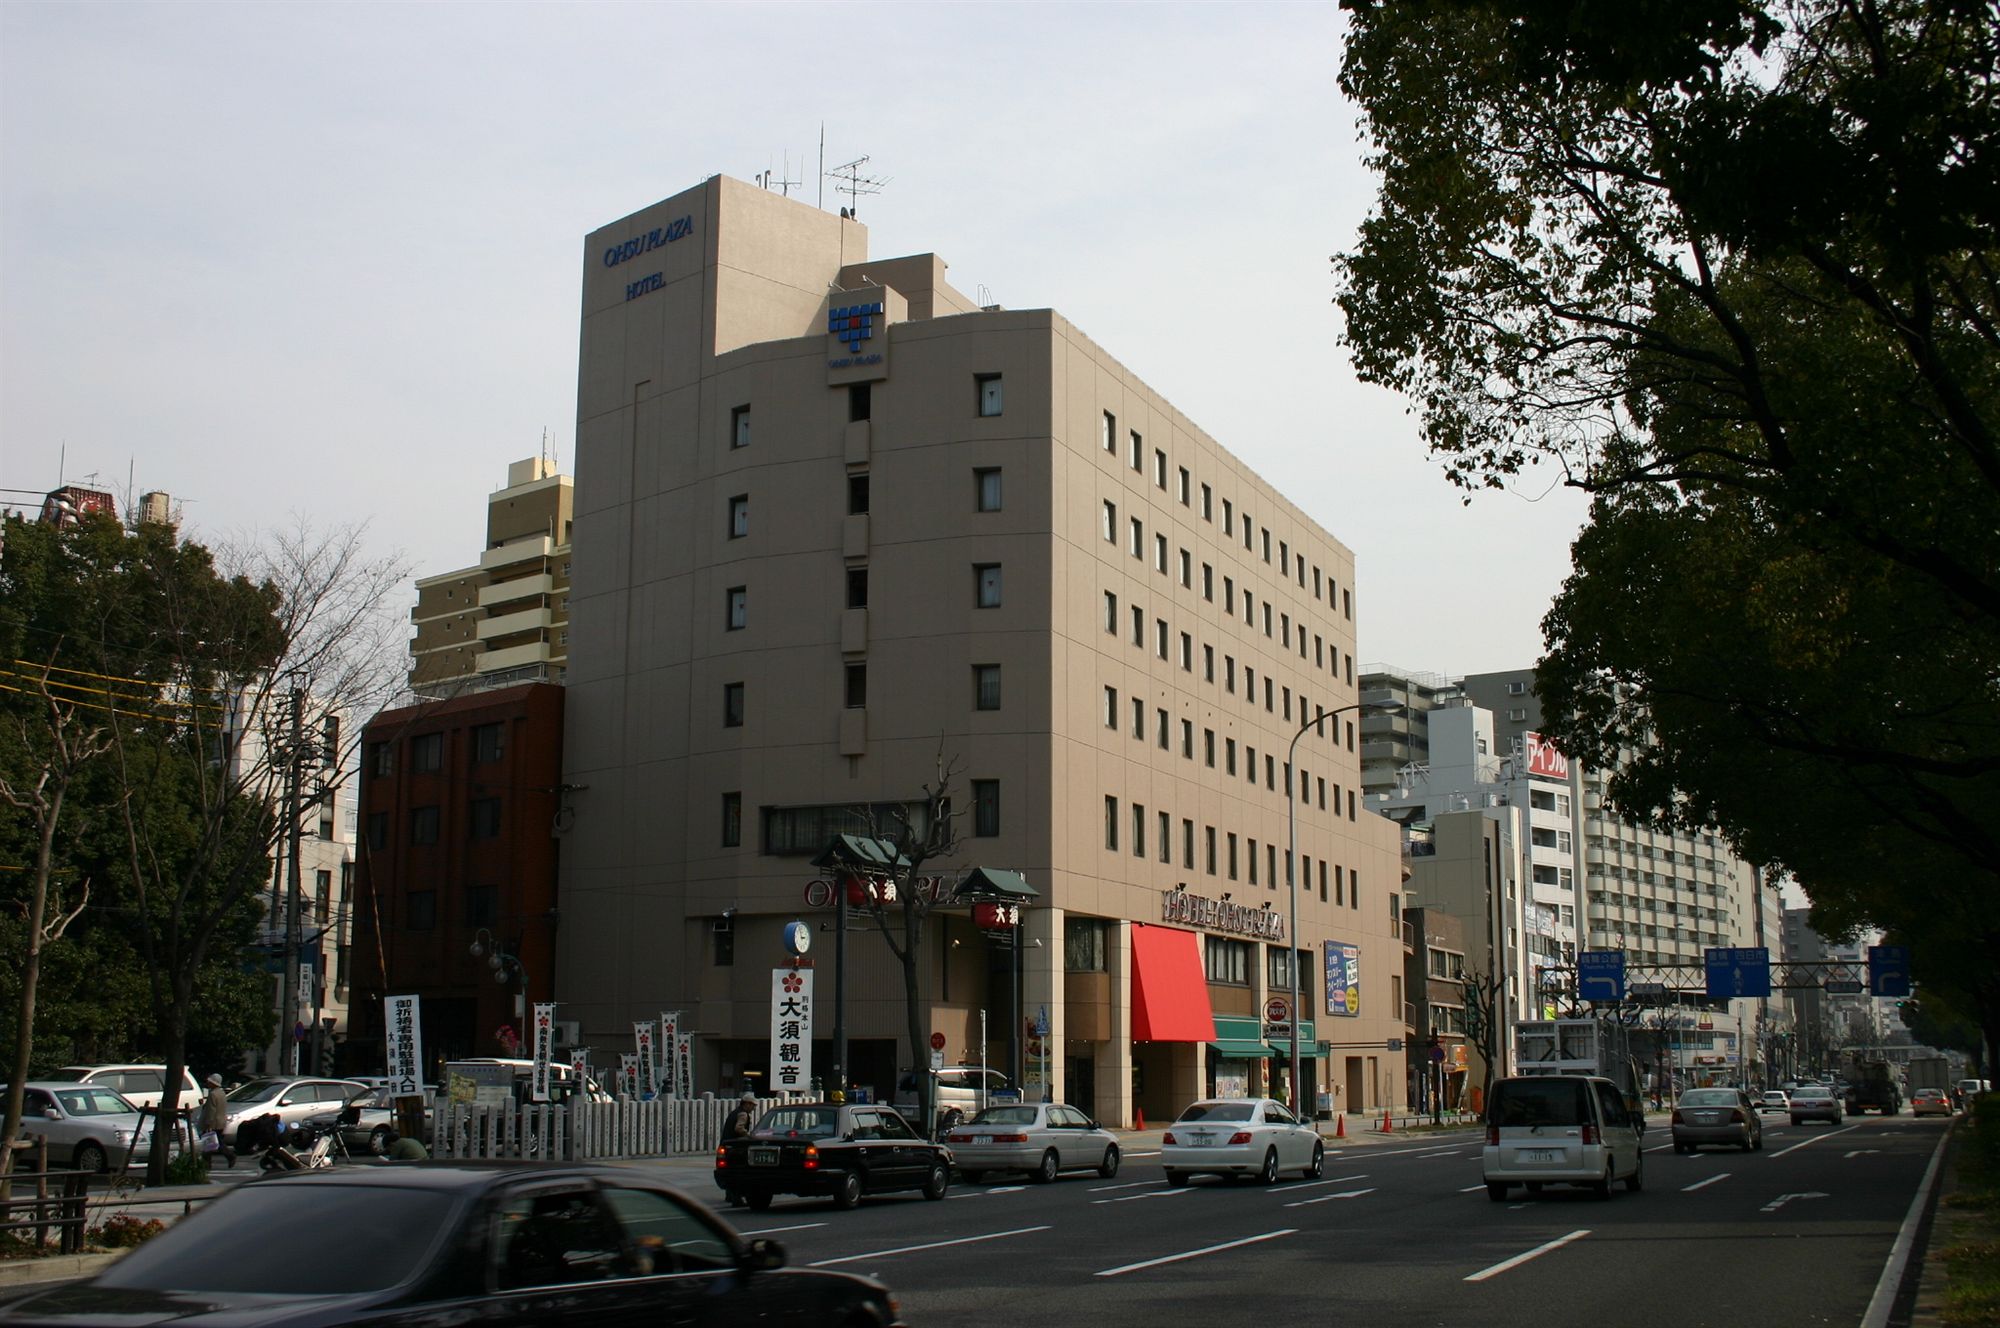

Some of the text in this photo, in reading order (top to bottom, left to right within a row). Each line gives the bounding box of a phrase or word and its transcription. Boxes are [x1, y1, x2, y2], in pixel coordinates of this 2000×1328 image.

[604, 215, 693, 268] OHSU PLAZA
[626, 272, 667, 301] HOTEL
[996, 904, 1019, 925] 大須
[1163, 890, 1285, 939] HOTEL OHSU PLAZA
[779, 997, 801, 1084] 大須観音
